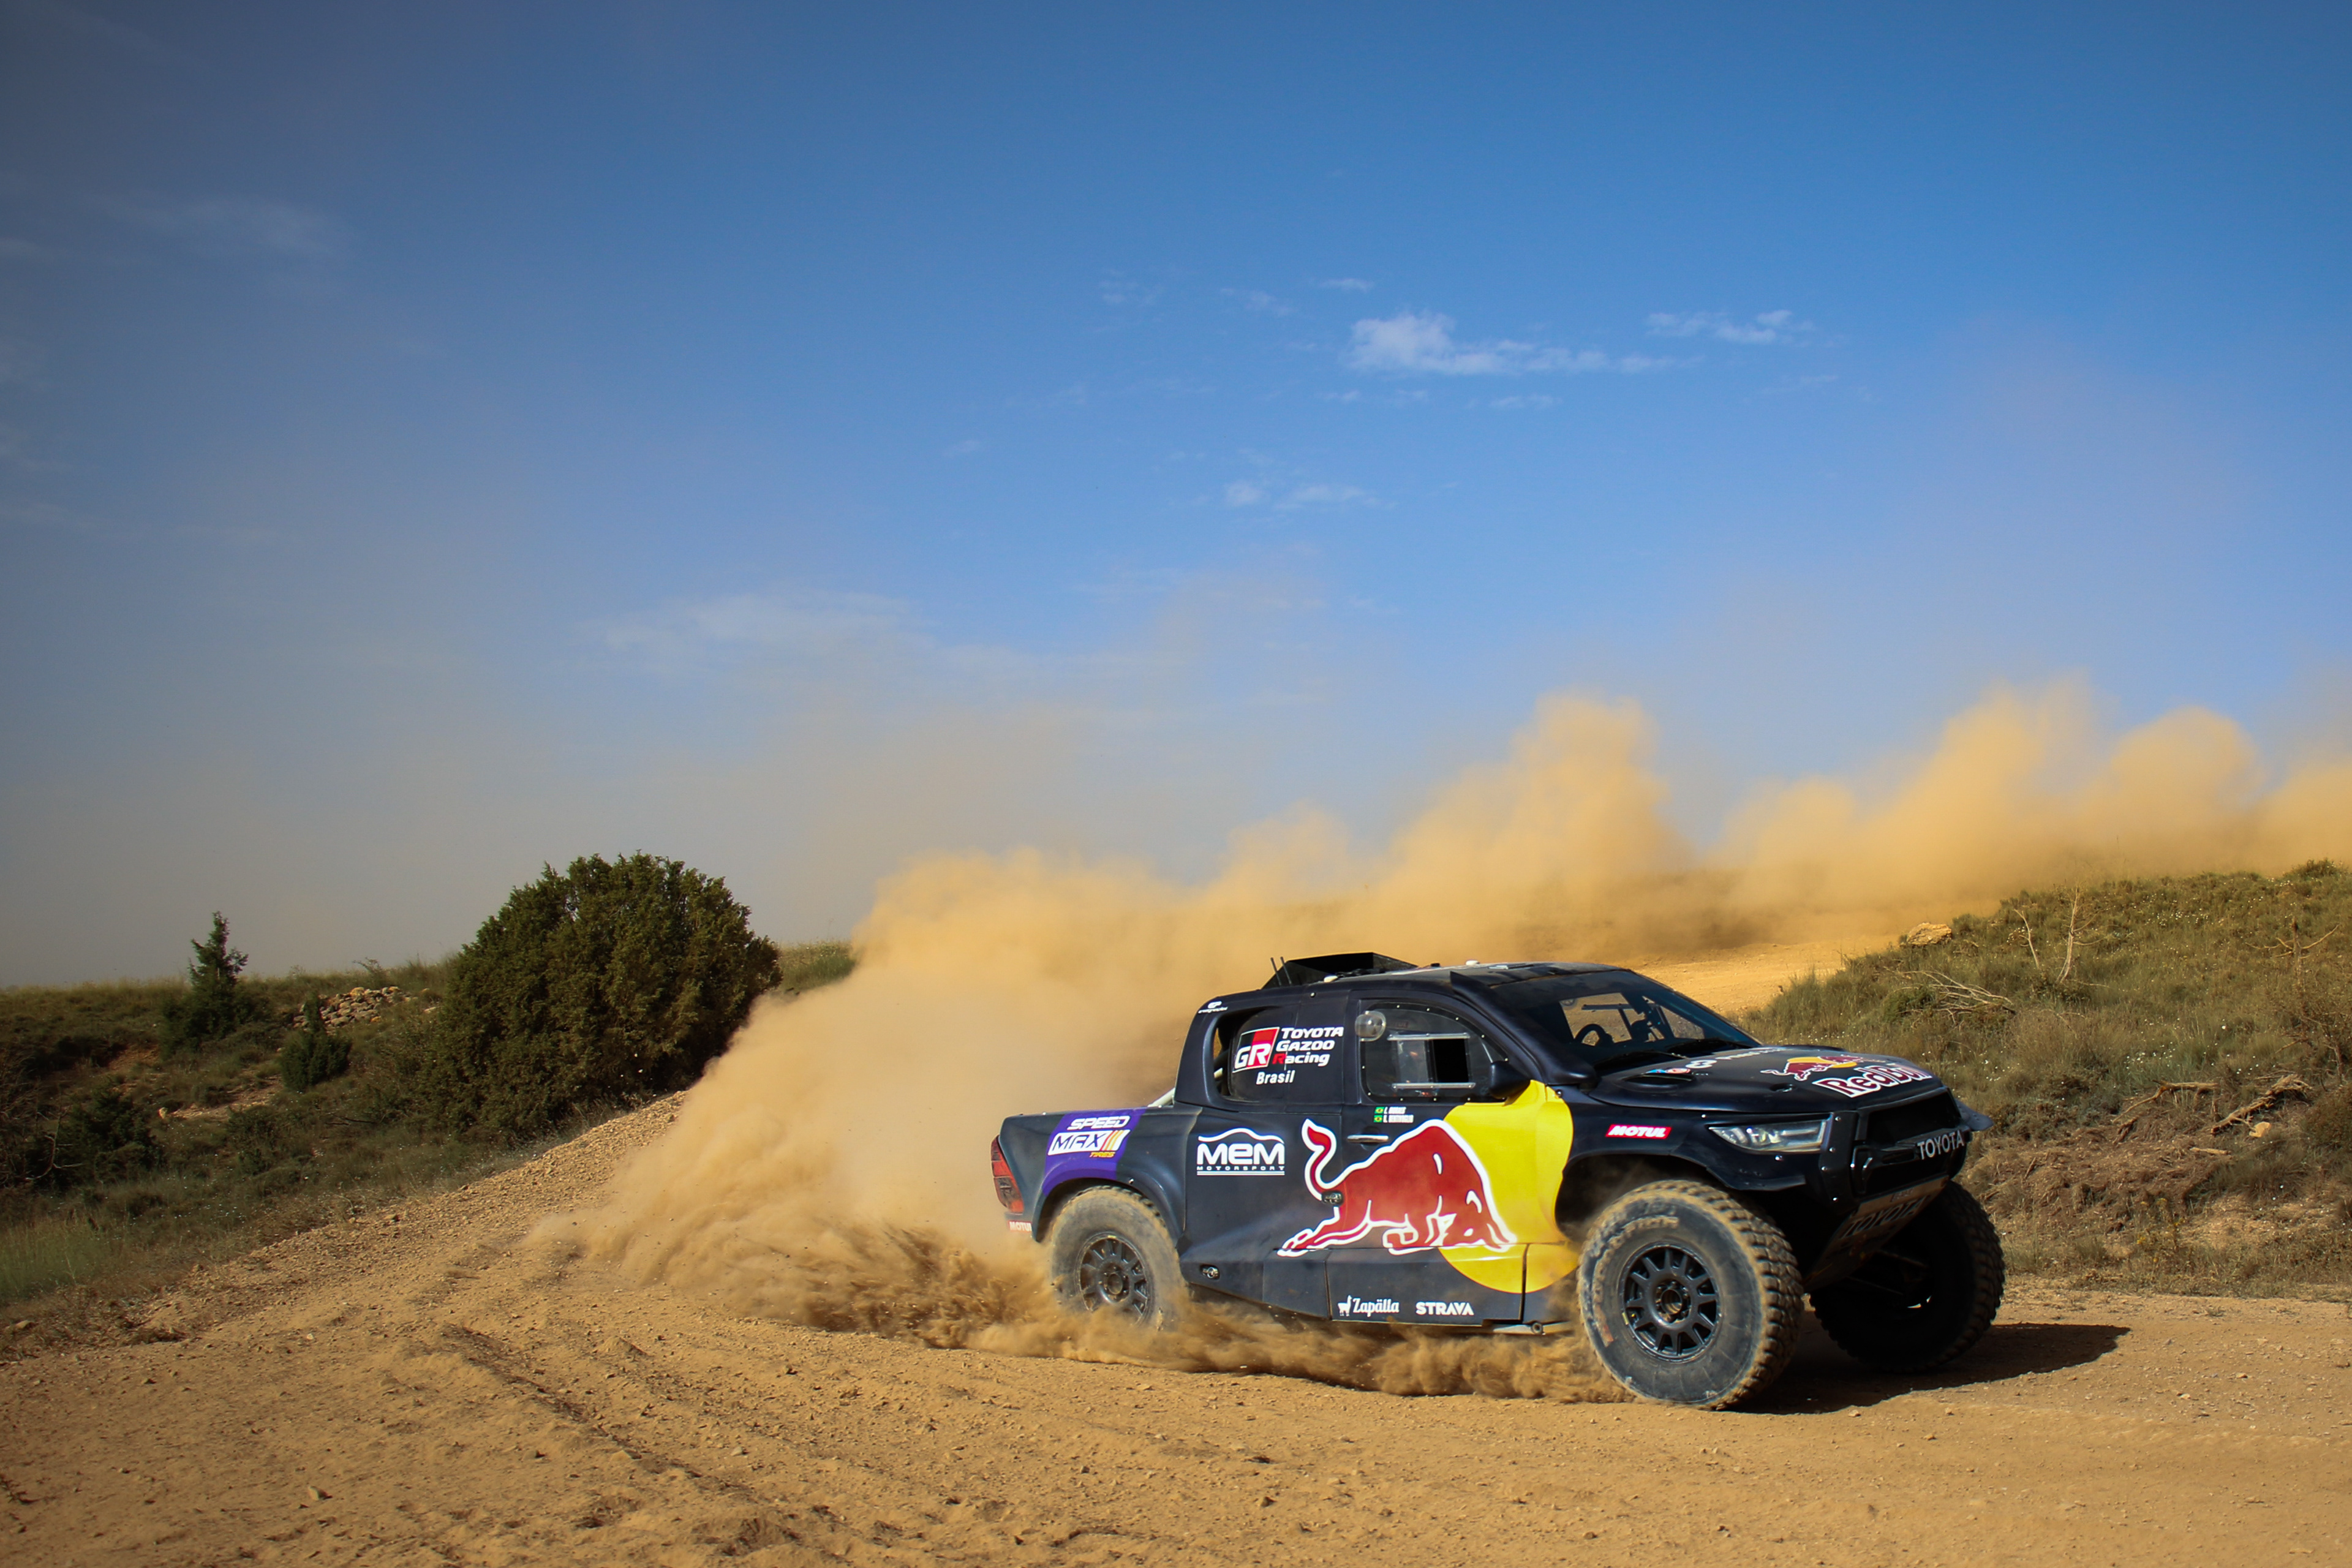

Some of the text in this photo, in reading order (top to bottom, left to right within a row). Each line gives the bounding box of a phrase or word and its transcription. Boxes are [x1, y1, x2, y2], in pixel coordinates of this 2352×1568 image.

[1281, 1027, 1344, 1039] TOYOTA
[1276, 1040, 1335, 1052] GAZOO
[1234, 1043, 1272, 1069] GR
[1272, 1052, 1330, 1067] Racing
[1256, 1070, 1295, 1085] Brasil
[1067, 1115, 1131, 1130] SPEED
[1608, 1125, 1666, 1137] MOTUL
[1917, 1129, 1964, 1160] TOYOTA
[1839, 1195, 1931, 1240] TOYOTA
[1009, 1221, 1032, 1232] MOTU
[1352, 1298, 1400, 1317] Zapälla
[1415, 1302, 1474, 1316] STRAVA
